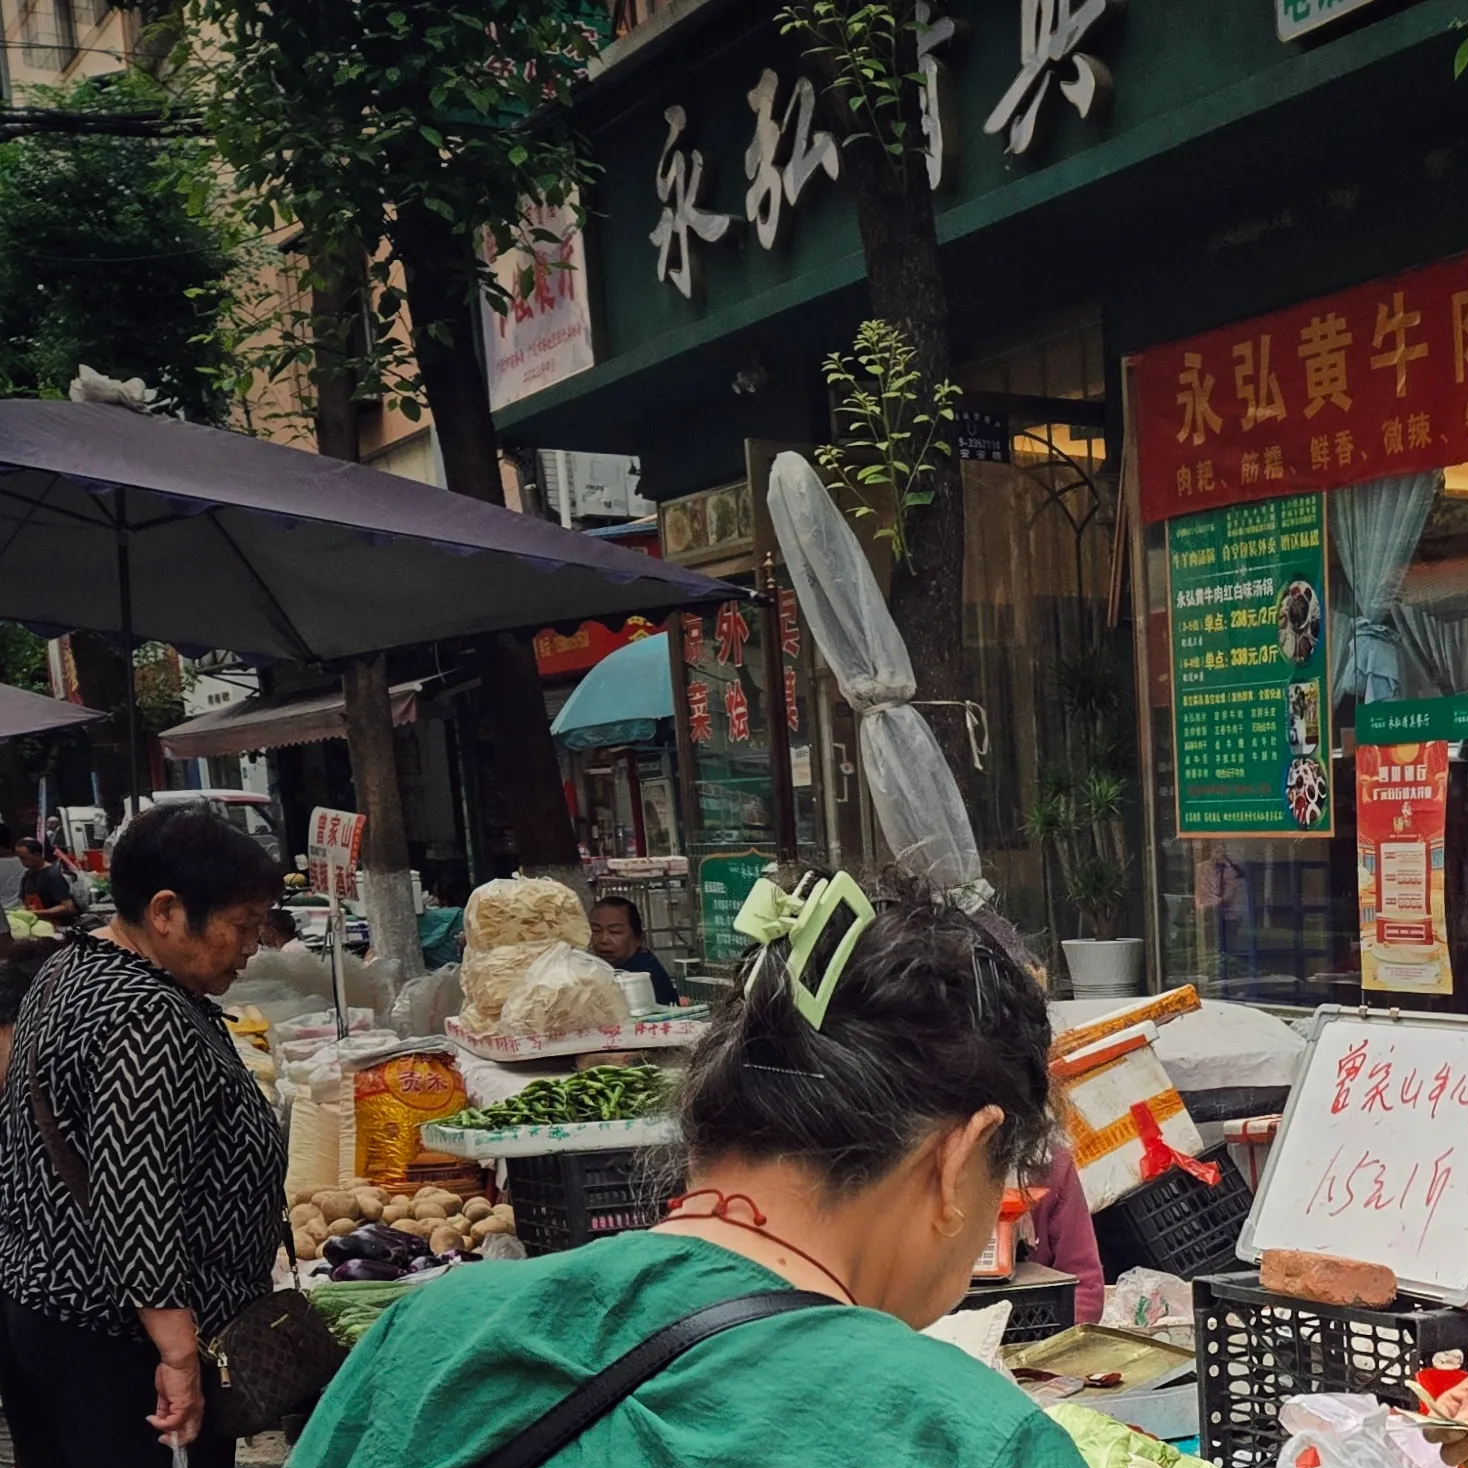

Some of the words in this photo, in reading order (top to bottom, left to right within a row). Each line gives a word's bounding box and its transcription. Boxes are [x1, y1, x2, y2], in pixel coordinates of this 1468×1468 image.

[1177, 578, 1274, 608] 永弘黄牛肉红白味汤锅
[316, 812, 353, 847] 曾家山
[398, 1070, 448, 1093] 贡米
